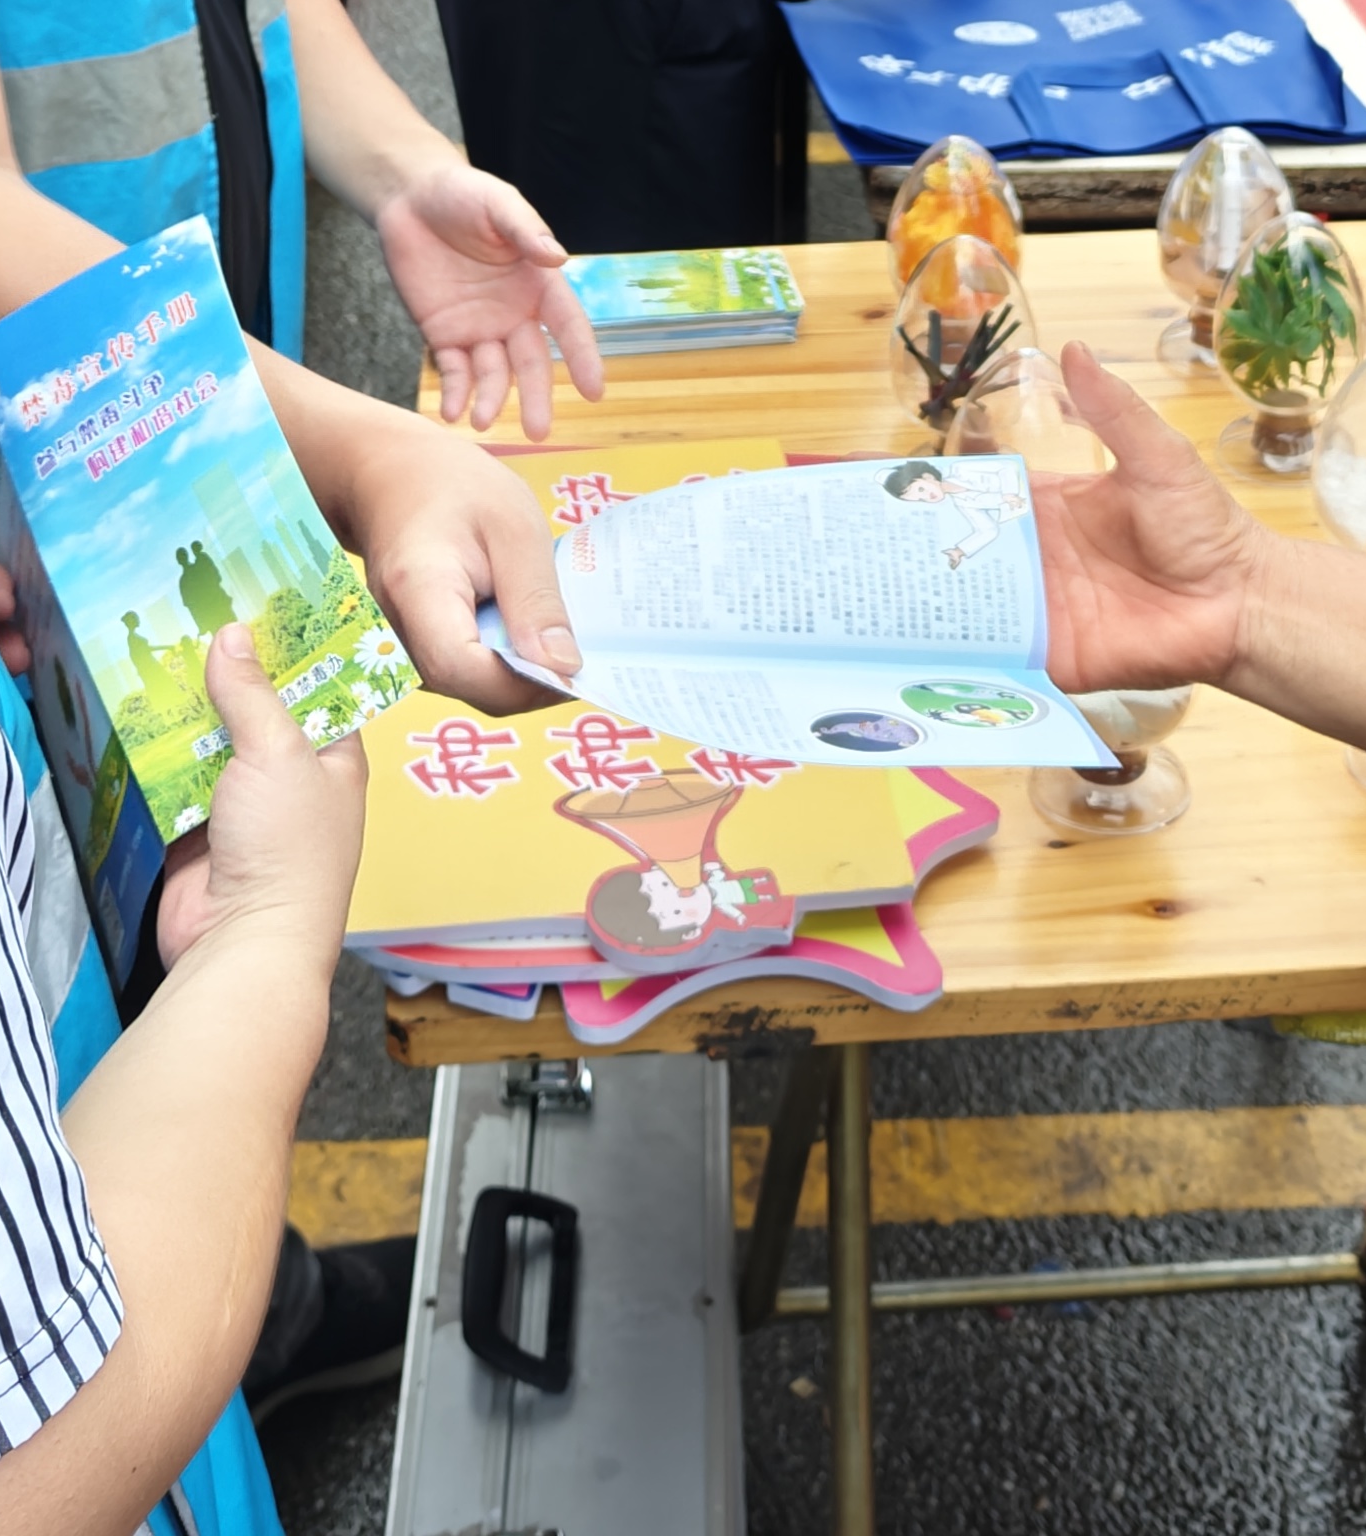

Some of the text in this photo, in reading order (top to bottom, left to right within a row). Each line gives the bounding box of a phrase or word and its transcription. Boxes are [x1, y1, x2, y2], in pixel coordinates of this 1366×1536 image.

[18, 290, 198, 430] 禁毒宣传手册
[85, 370, 221, 483] 构建和谐社会
